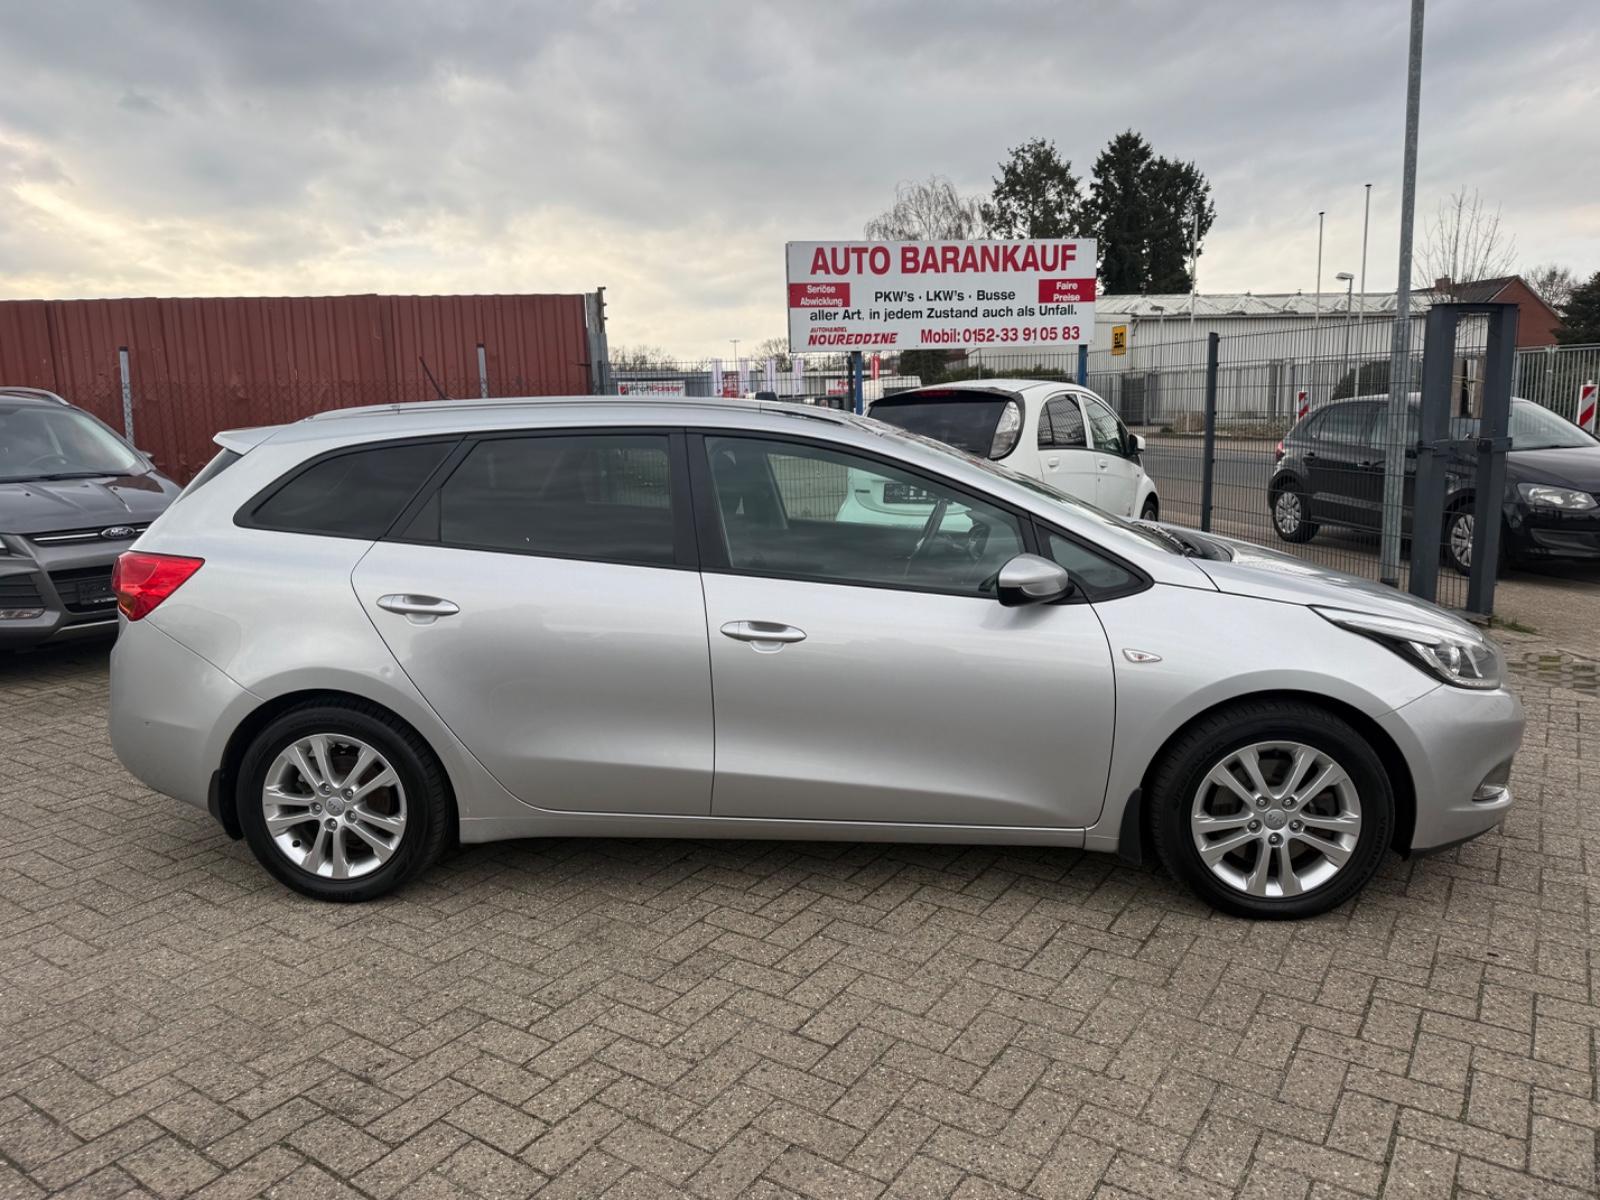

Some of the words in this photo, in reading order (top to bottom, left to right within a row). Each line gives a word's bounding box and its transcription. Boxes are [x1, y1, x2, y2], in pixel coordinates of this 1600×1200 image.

[810, 245, 891, 276] AUTO
[901, 244, 1077, 274] BARANKAUF
[807, 284, 836, 294] Seriöse
[1056, 281, 1078, 290] Faire
[874, 291, 915, 302] PKW's
[926, 290, 965, 302] LKW's
[976, 290, 1016, 301] Busse
[1053, 293, 1080, 302] Preise
[800, 297, 843, 307] Abwicklung
[809, 309, 839, 321] aller
[869, 308, 880, 320] in
[883, 308, 923, 322] jedem
[926, 307, 978, 319] Zustand
[982, 306, 1013, 318] auch
[1016, 305, 1035, 317] als
[1039, 304, 1078, 316] Unfall.
[808, 333, 898, 346] NOUREDDINE
